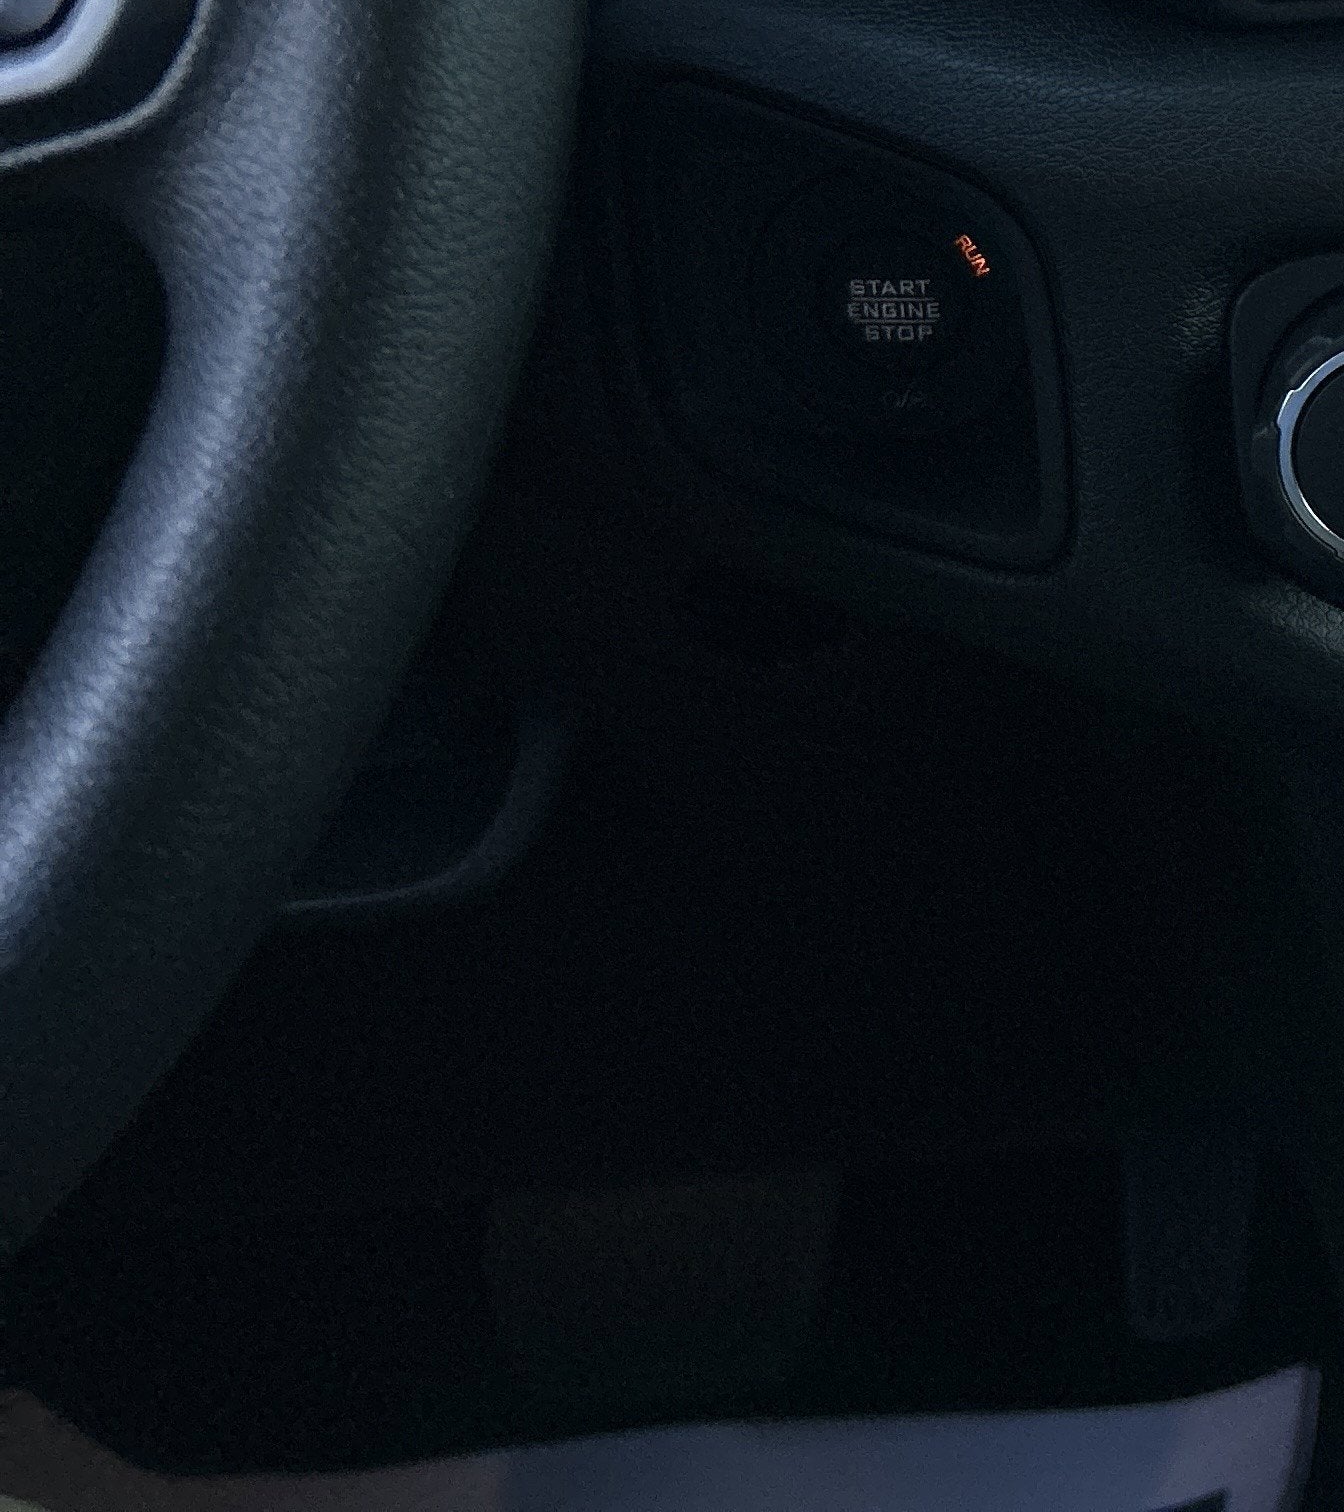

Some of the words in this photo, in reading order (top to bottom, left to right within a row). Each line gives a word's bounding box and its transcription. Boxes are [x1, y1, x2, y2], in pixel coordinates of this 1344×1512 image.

[954, 234, 991, 277] RUN
[851, 279, 930, 296] START
[848, 302, 940, 318] ENGINE
[866, 325, 932, 341] STOP
